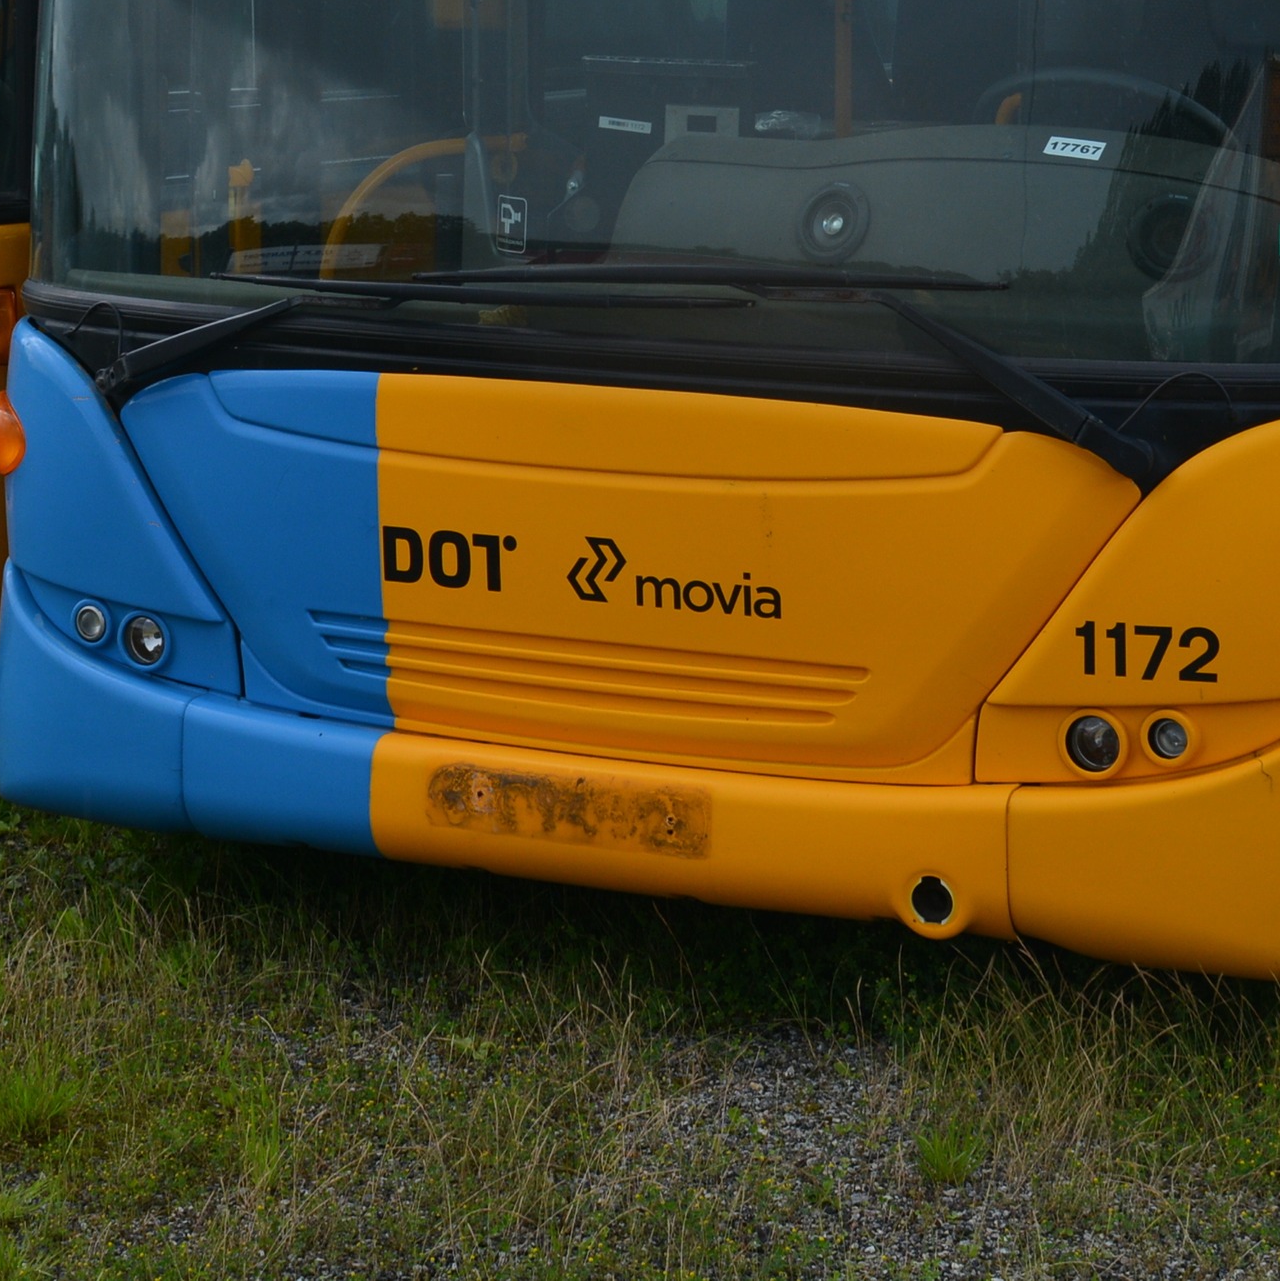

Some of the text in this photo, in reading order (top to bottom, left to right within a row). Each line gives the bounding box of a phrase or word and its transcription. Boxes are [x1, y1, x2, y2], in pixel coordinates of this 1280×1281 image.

[1050, 141, 1102, 155] 17767
[382, 525, 783, 620] DOT movia
[1075, 620, 1222, 684] 1172
